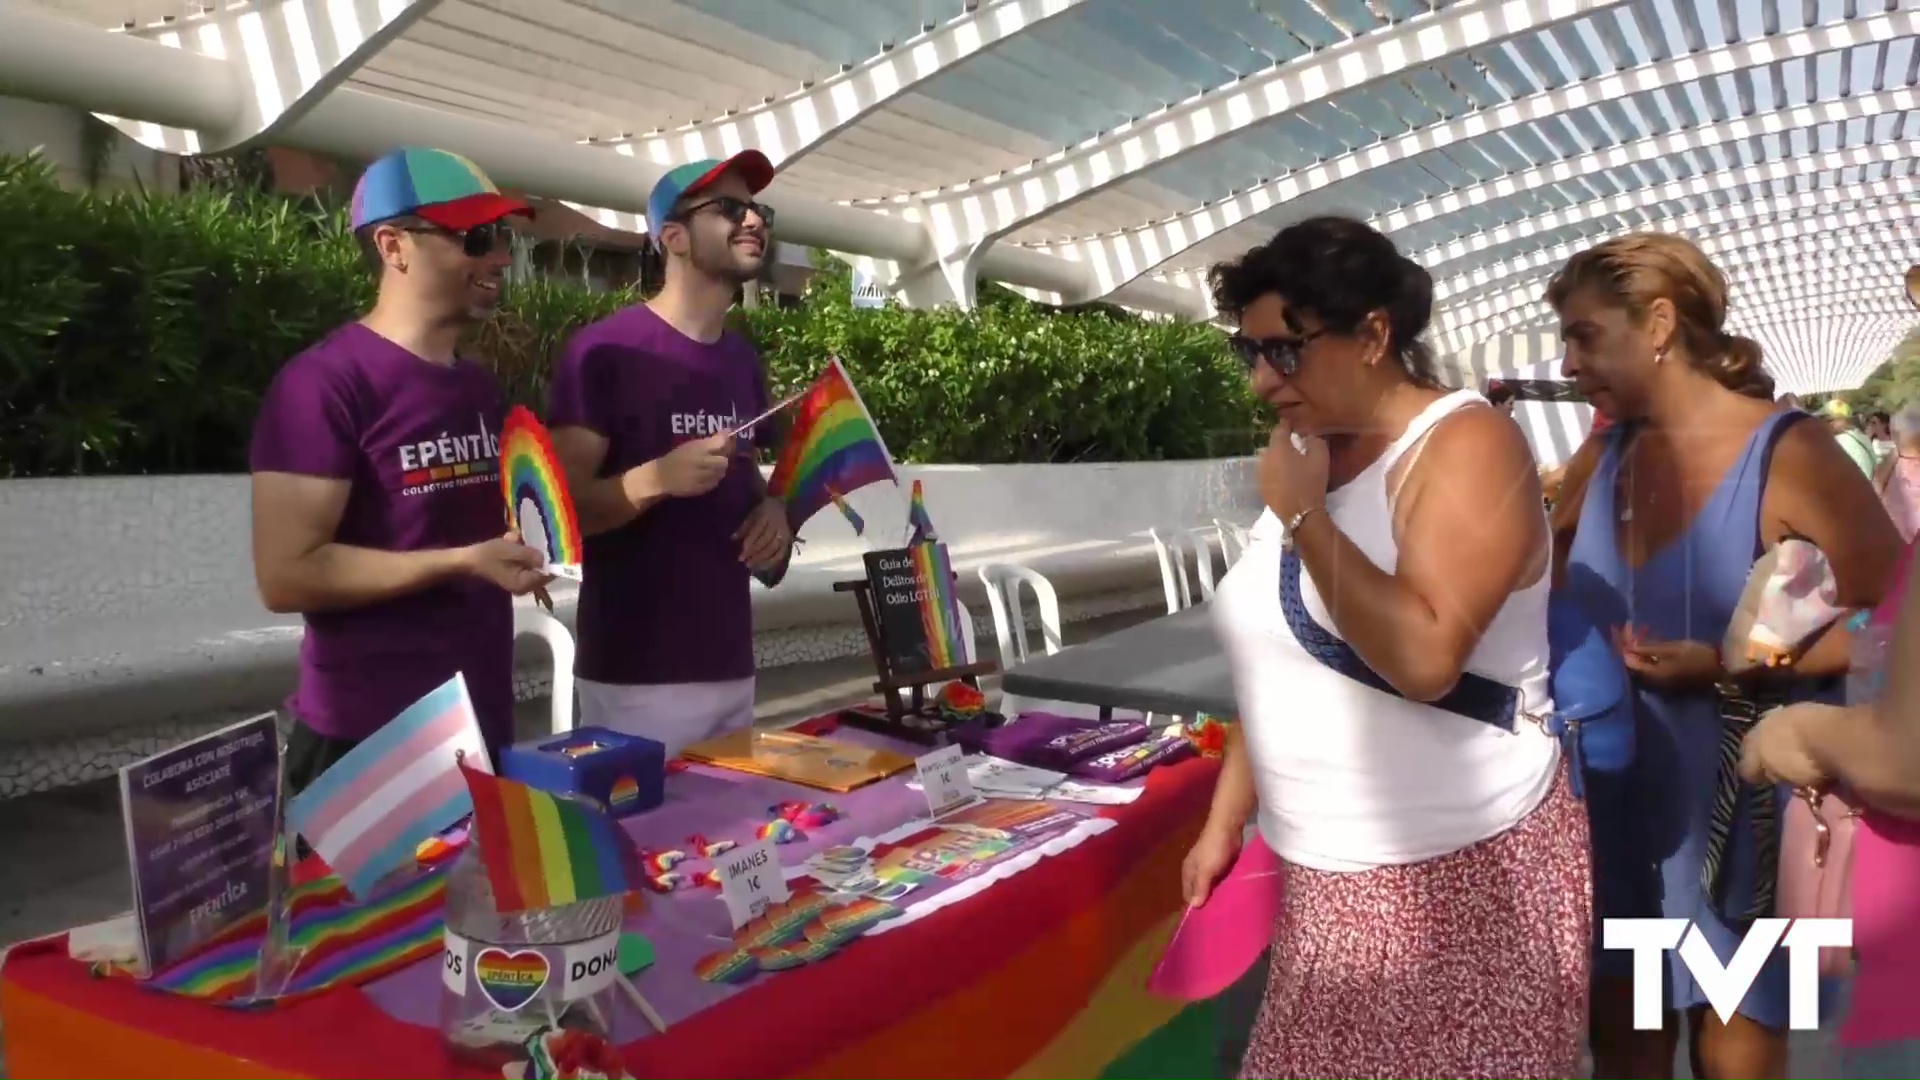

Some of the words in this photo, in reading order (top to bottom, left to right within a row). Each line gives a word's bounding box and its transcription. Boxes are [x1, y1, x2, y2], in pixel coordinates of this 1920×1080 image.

[398, 412, 501, 471] EPÉNTIC
[402, 480, 455, 496] COLECTIVO
[902, 557, 915, 568] de
[883, 575, 915, 588] Delitos
[886, 592, 909, 604] Odio
[143, 758, 194, 788] COLABORA
[195, 750, 215, 767] CON
[728, 849, 768, 879] IMANES
